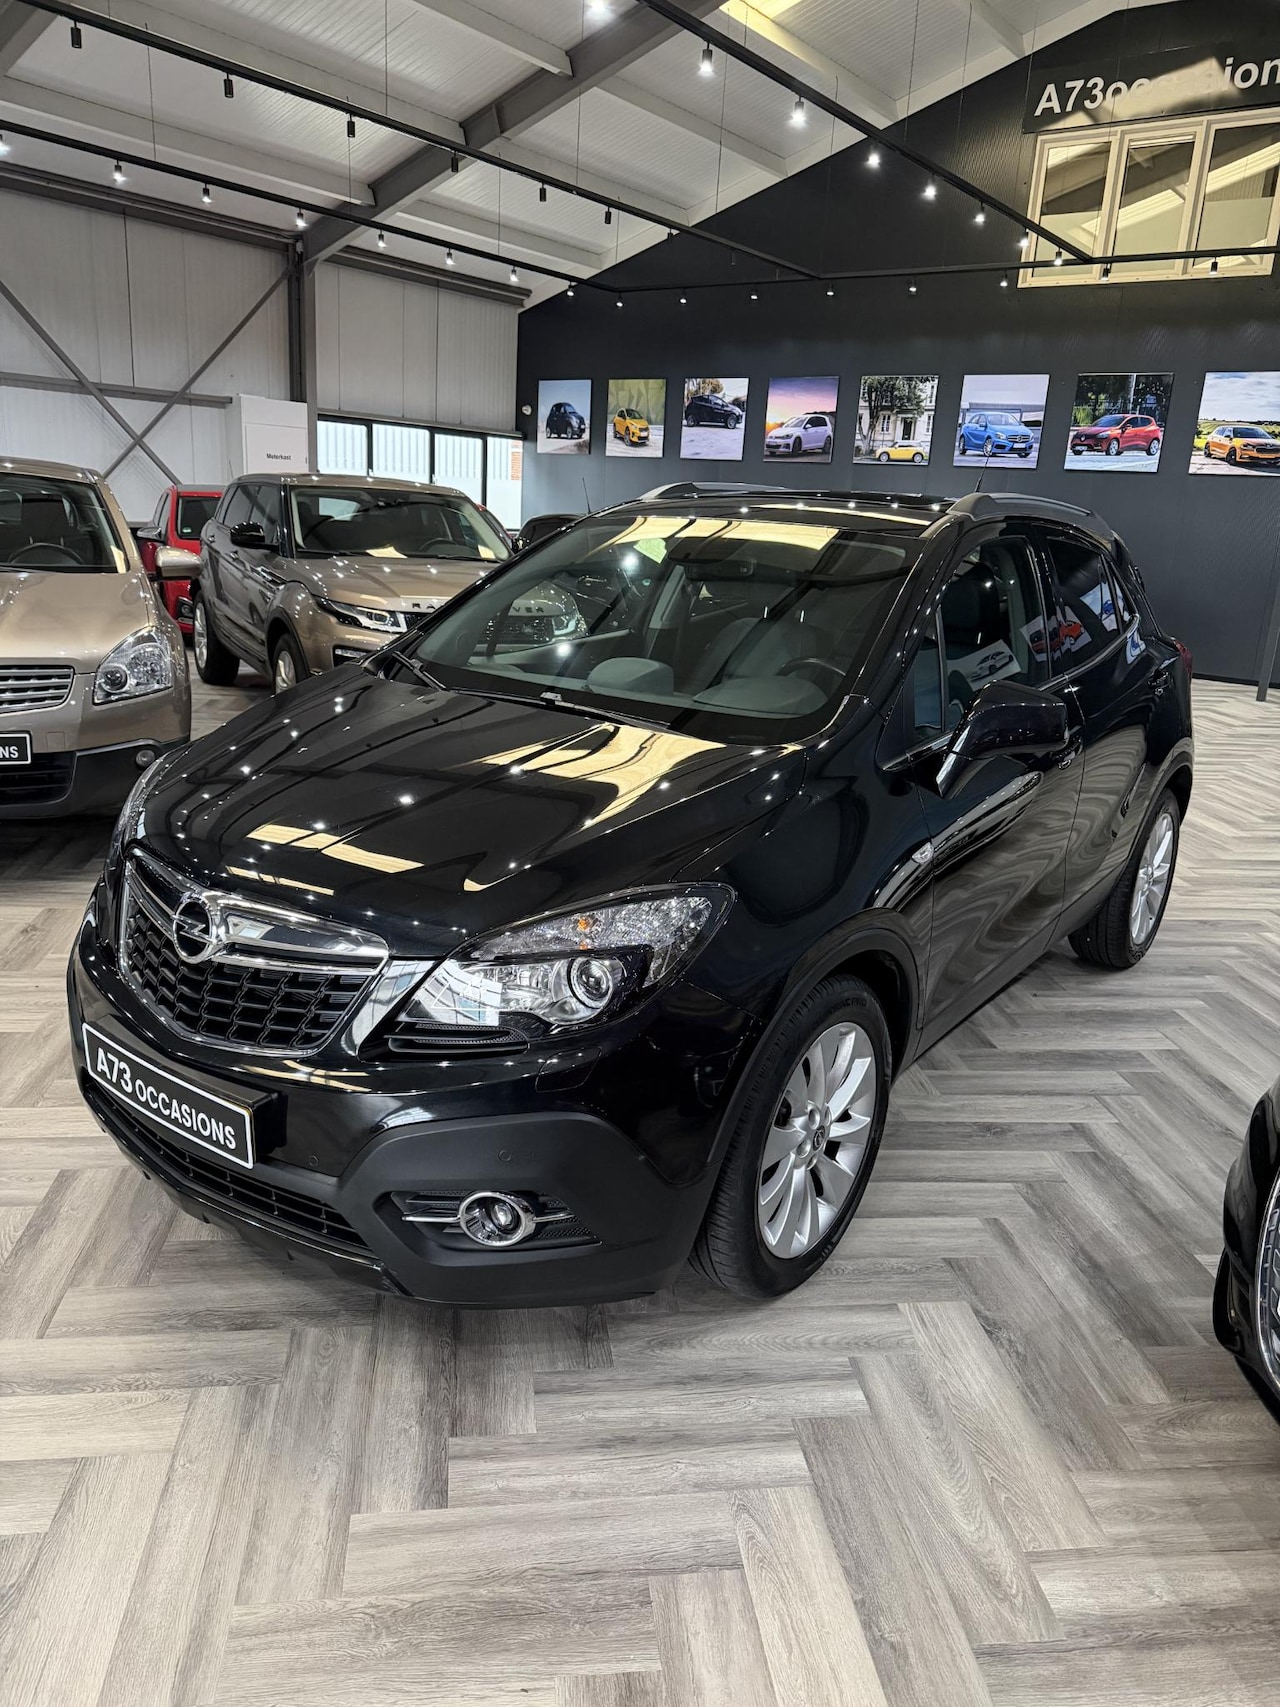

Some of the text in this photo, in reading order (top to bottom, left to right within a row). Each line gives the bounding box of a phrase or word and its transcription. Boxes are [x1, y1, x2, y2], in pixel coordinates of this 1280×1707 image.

[266, 452, 292, 461] Meterkast
[97, 1047, 236, 1150] A73 OCCASIONS
